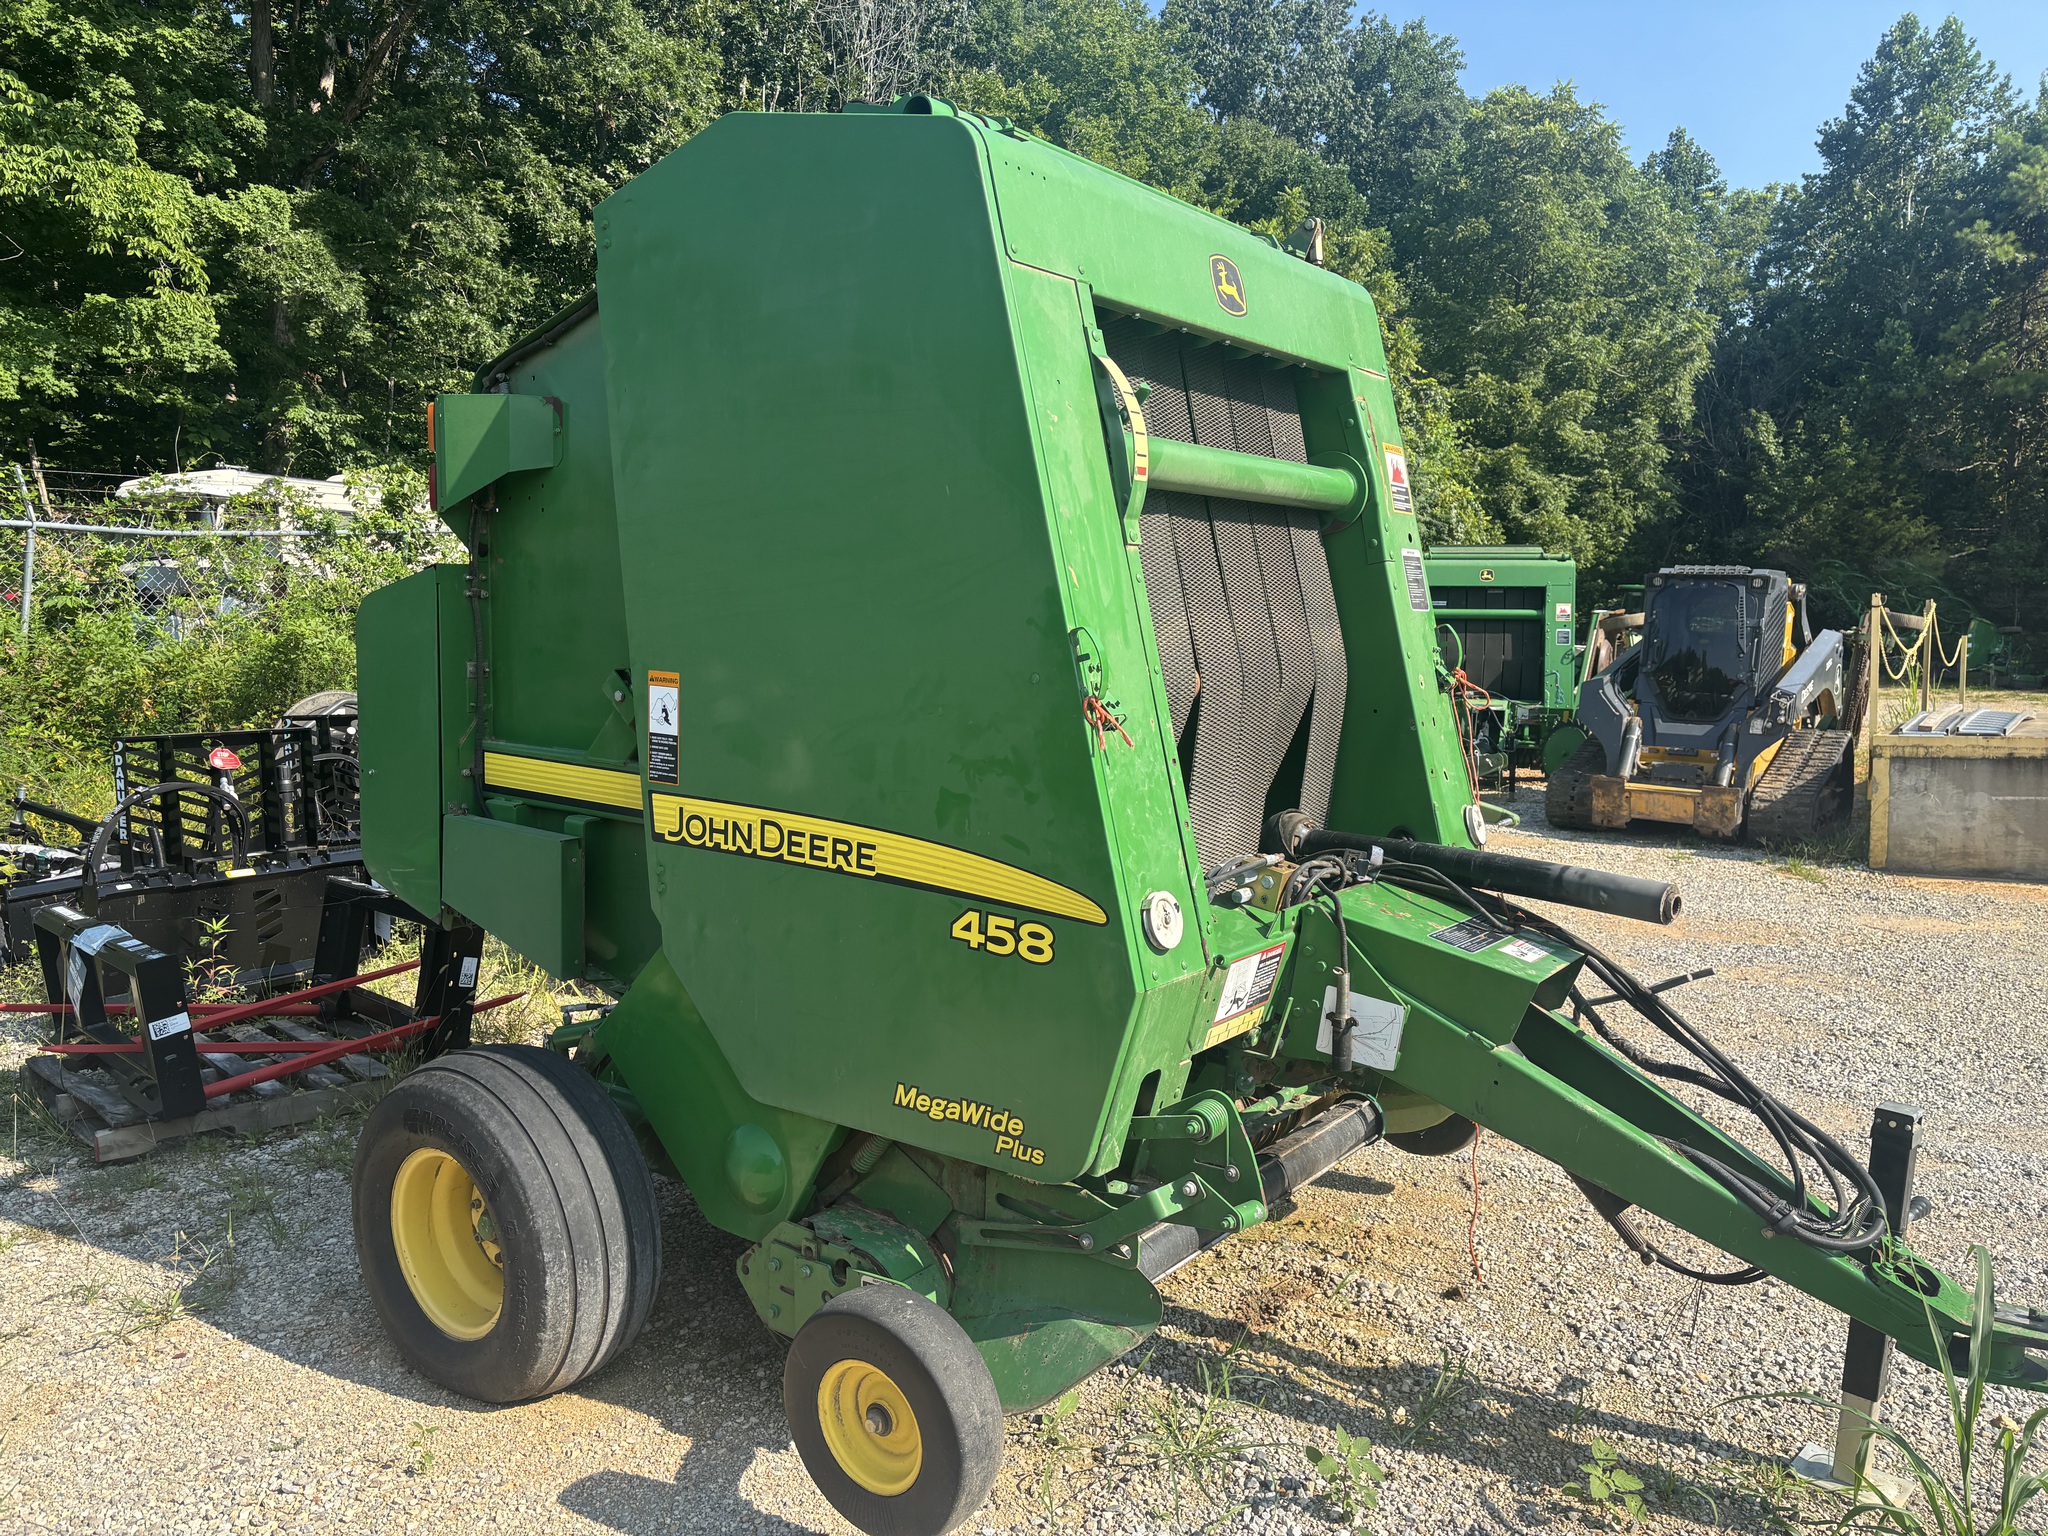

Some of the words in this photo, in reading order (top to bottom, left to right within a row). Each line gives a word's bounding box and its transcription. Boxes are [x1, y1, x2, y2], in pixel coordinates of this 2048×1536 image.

[114, 754, 129, 841] DANUER
[668, 806, 753, 850] JOHN
[759, 819, 877, 872] DEERE
[950, 908, 1055, 965] 458
[893, 1081, 1025, 1137] MegaWide
[994, 1134, 1046, 1166] Plus
